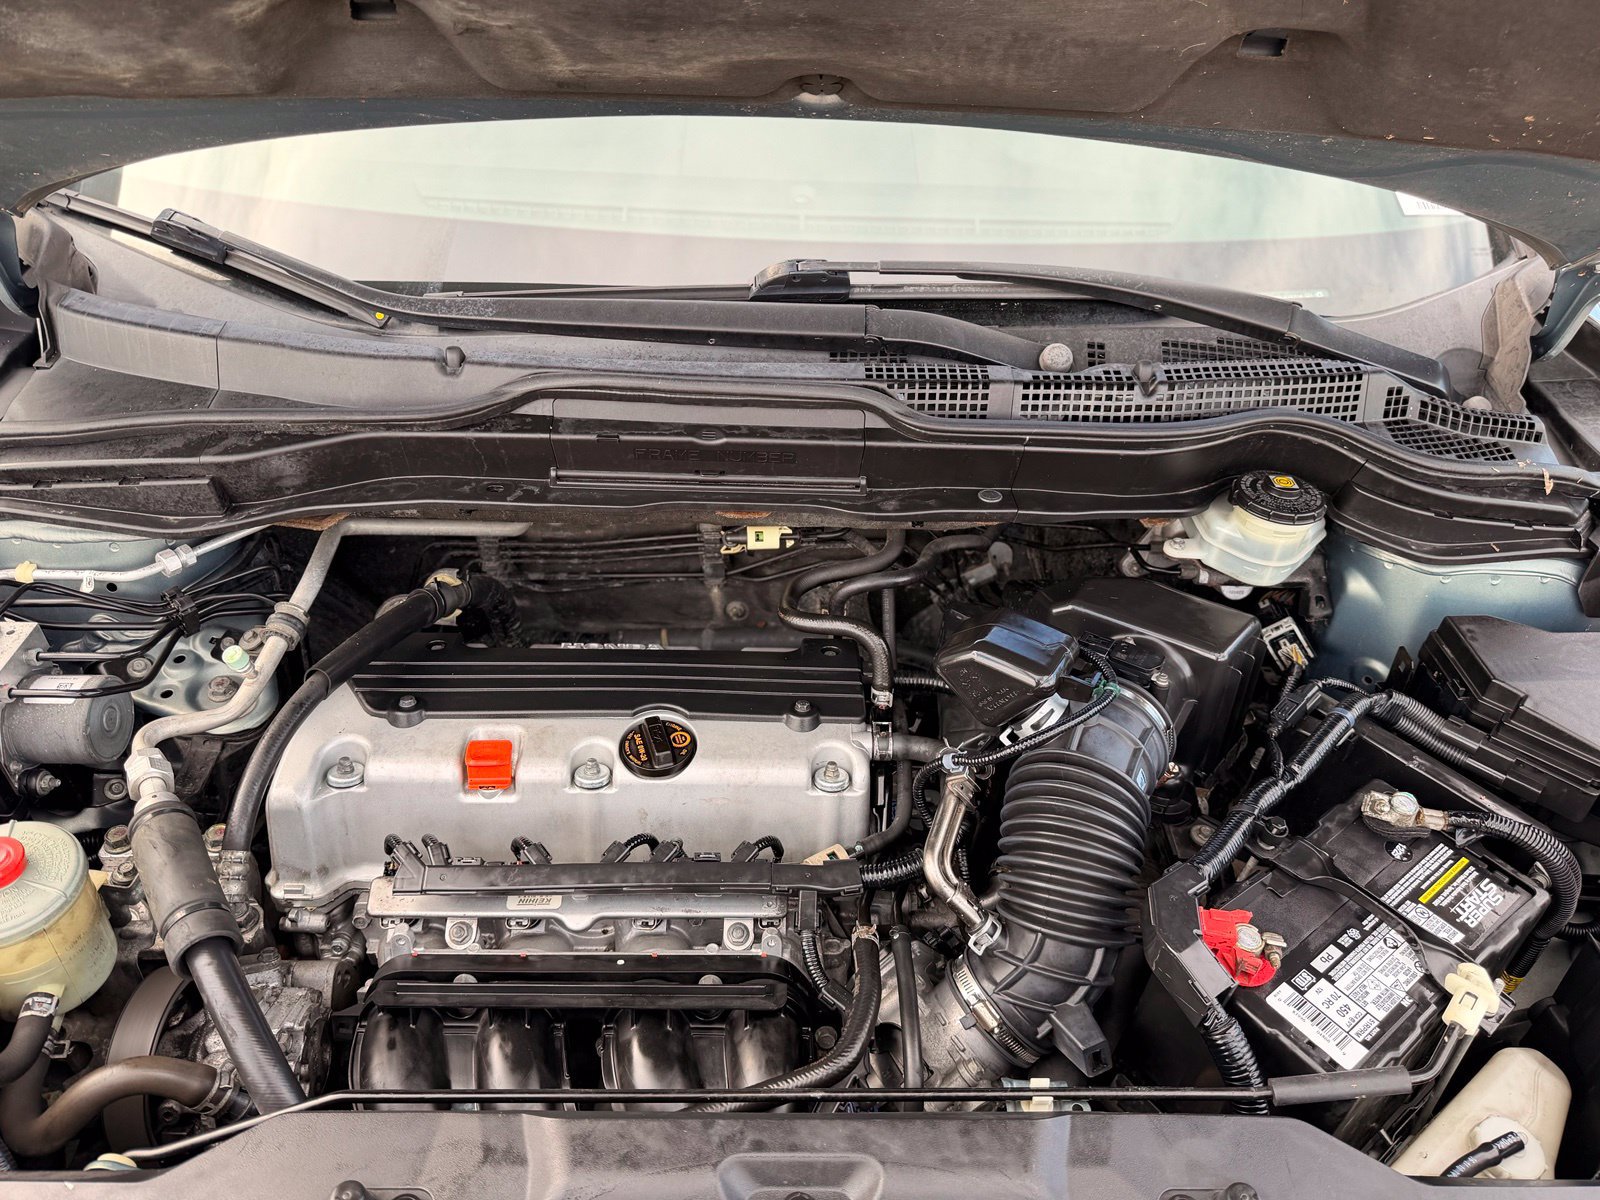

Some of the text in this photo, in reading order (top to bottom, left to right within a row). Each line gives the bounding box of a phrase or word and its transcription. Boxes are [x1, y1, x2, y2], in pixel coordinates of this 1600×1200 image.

[633, 447, 798, 464] FRAME NUMBER
[1458, 878, 1496, 918] START
[1463, 891, 1503, 927] SUPER
[1318, 951, 1333, 964] Pb
[1320, 991, 1341, 1009] 70 RC
[1334, 1002, 1353, 1018] 450
[1353, 1018, 1376, 1038] 51RPRM
